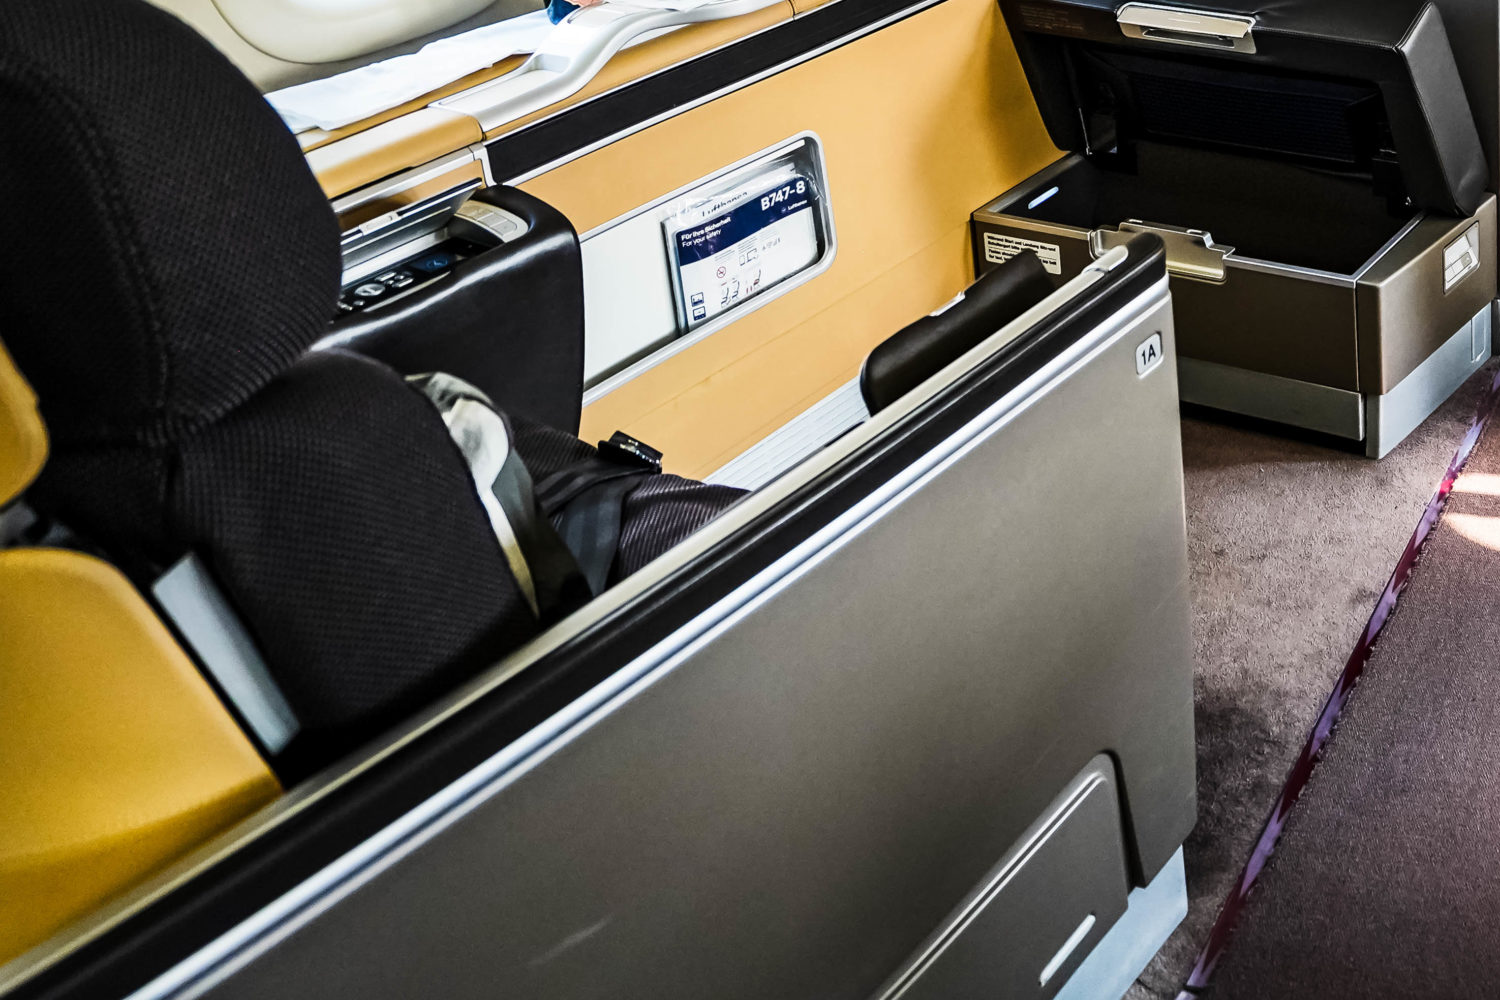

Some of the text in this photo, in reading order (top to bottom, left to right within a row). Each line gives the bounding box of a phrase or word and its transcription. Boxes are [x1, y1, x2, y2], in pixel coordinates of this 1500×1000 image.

[760, 180, 806, 211] B747-8
[682, 239, 693, 248] For
[1141, 344, 1156, 366] 1A
